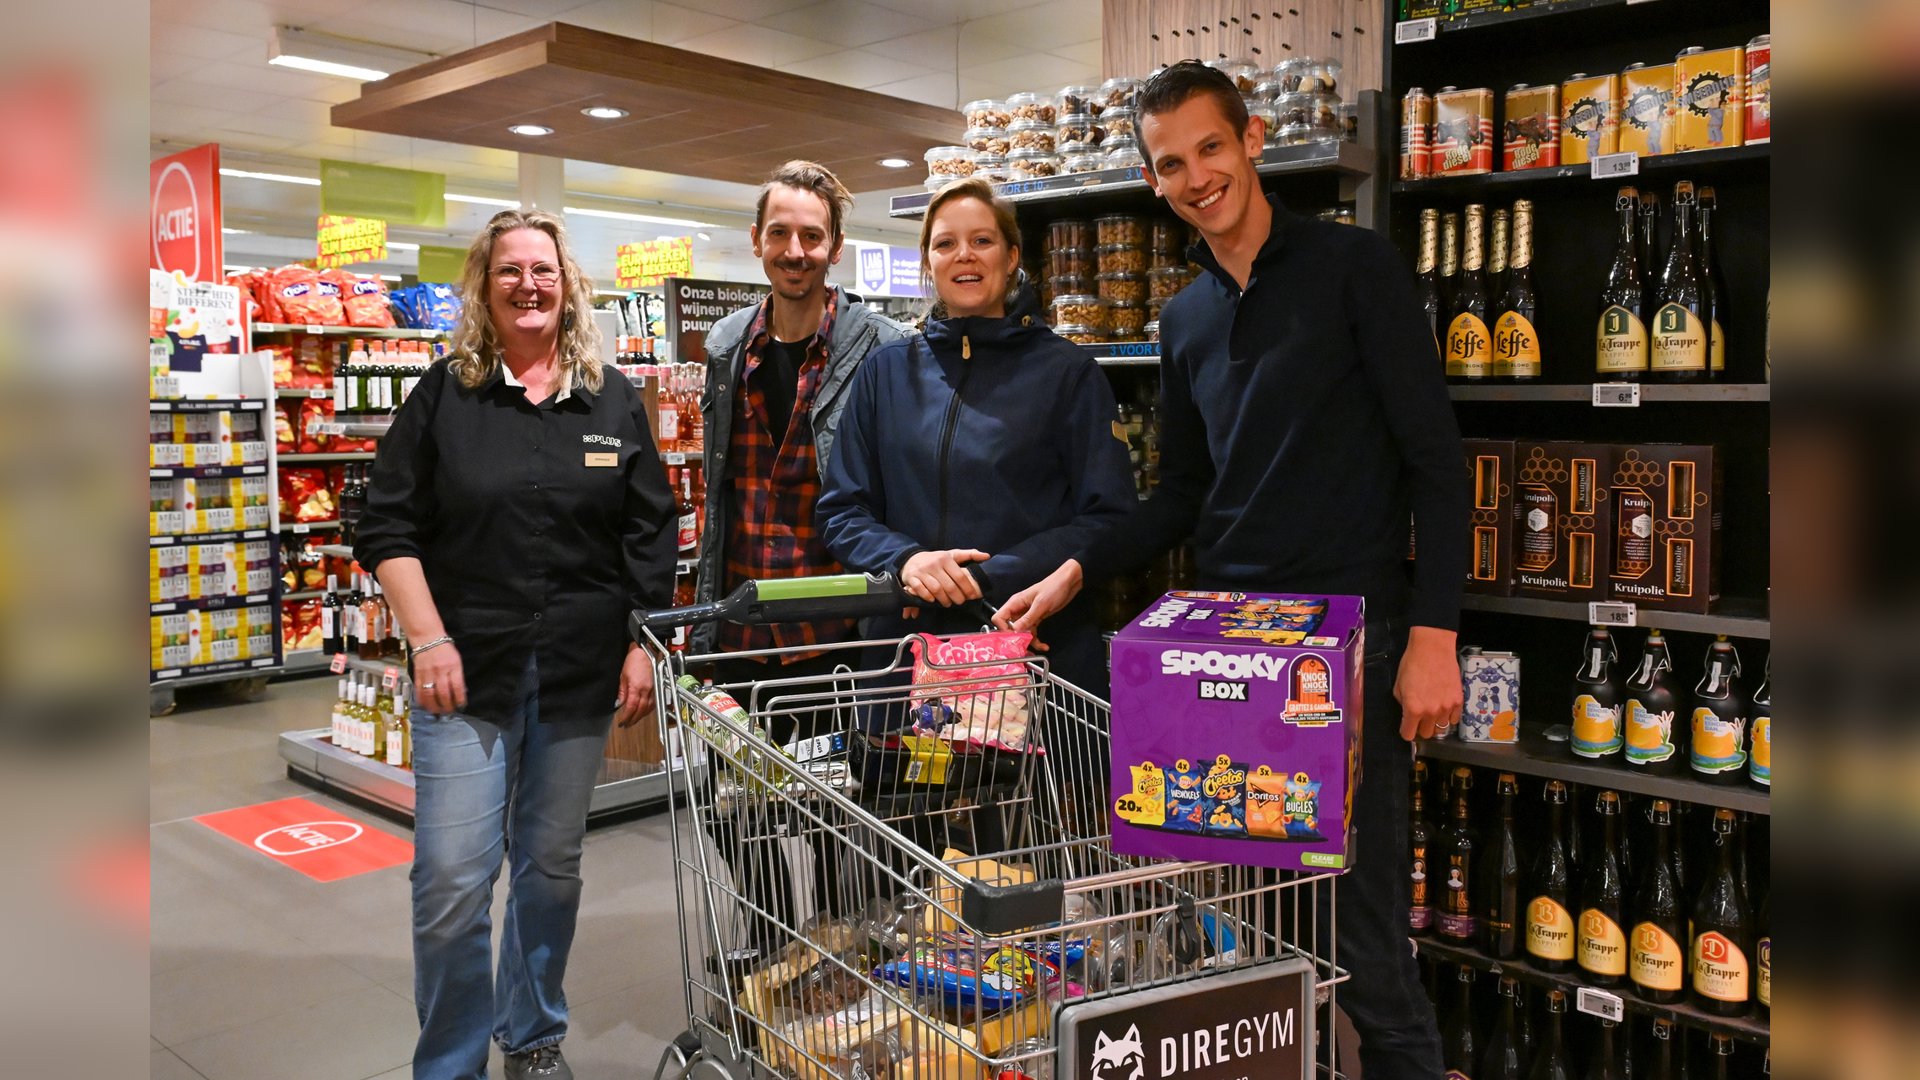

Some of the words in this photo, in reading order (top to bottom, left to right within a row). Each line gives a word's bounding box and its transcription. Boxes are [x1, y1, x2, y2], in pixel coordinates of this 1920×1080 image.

[158, 207, 194, 242] ACTIE
[680, 285, 714, 300] Onze
[718, 287, 768, 304] biologis
[681, 304, 724, 318] wijnen
[682, 321, 713, 333] puur
[1110, 345, 1117, 356] 3
[1120, 344, 1152, 356] VOOR
[1449, 330, 1485, 359] Leffe
[1496, 328, 1530, 358] Leffe
[1606, 337, 1641, 352] Trappe
[1662, 336, 1698, 350] Trappe
[591, 434, 622, 447] PLUS
[1624, 498, 1650, 507] Kruip
[1521, 575, 1568, 588] Kruipolie
[1614, 582, 1665, 597] Kruipolie
[1161, 649, 1288, 681] SPOOKY
[1302, 672, 1327, 681] KNOCK
[1200, 682, 1246, 700] BOX
[1303, 681, 1329, 689] KNOCK
[1142, 764, 1153, 772] 4x
[1177, 762, 1187, 770] 4x
[1218, 757, 1228, 765] 5x
[1259, 768, 1270, 776] 3x
[1296, 775, 1307, 783] 4x
[1203, 770, 1244, 797] Cheetos
[1247, 791, 1279, 802] Doritos
[1118, 799, 1142, 813] 20x
[1286, 801, 1314, 814] BUGLES
[282, 826, 336, 847] ACTIE
[1535, 924, 1568, 940] Trappe
[1584, 937, 1618, 954] Trappe
[1704, 938, 1725, 959] D
[1638, 952, 1674, 969] Trappe
[1703, 962, 1740, 980] Trappe
[1161, 1008, 1294, 1078] DIREGYM
